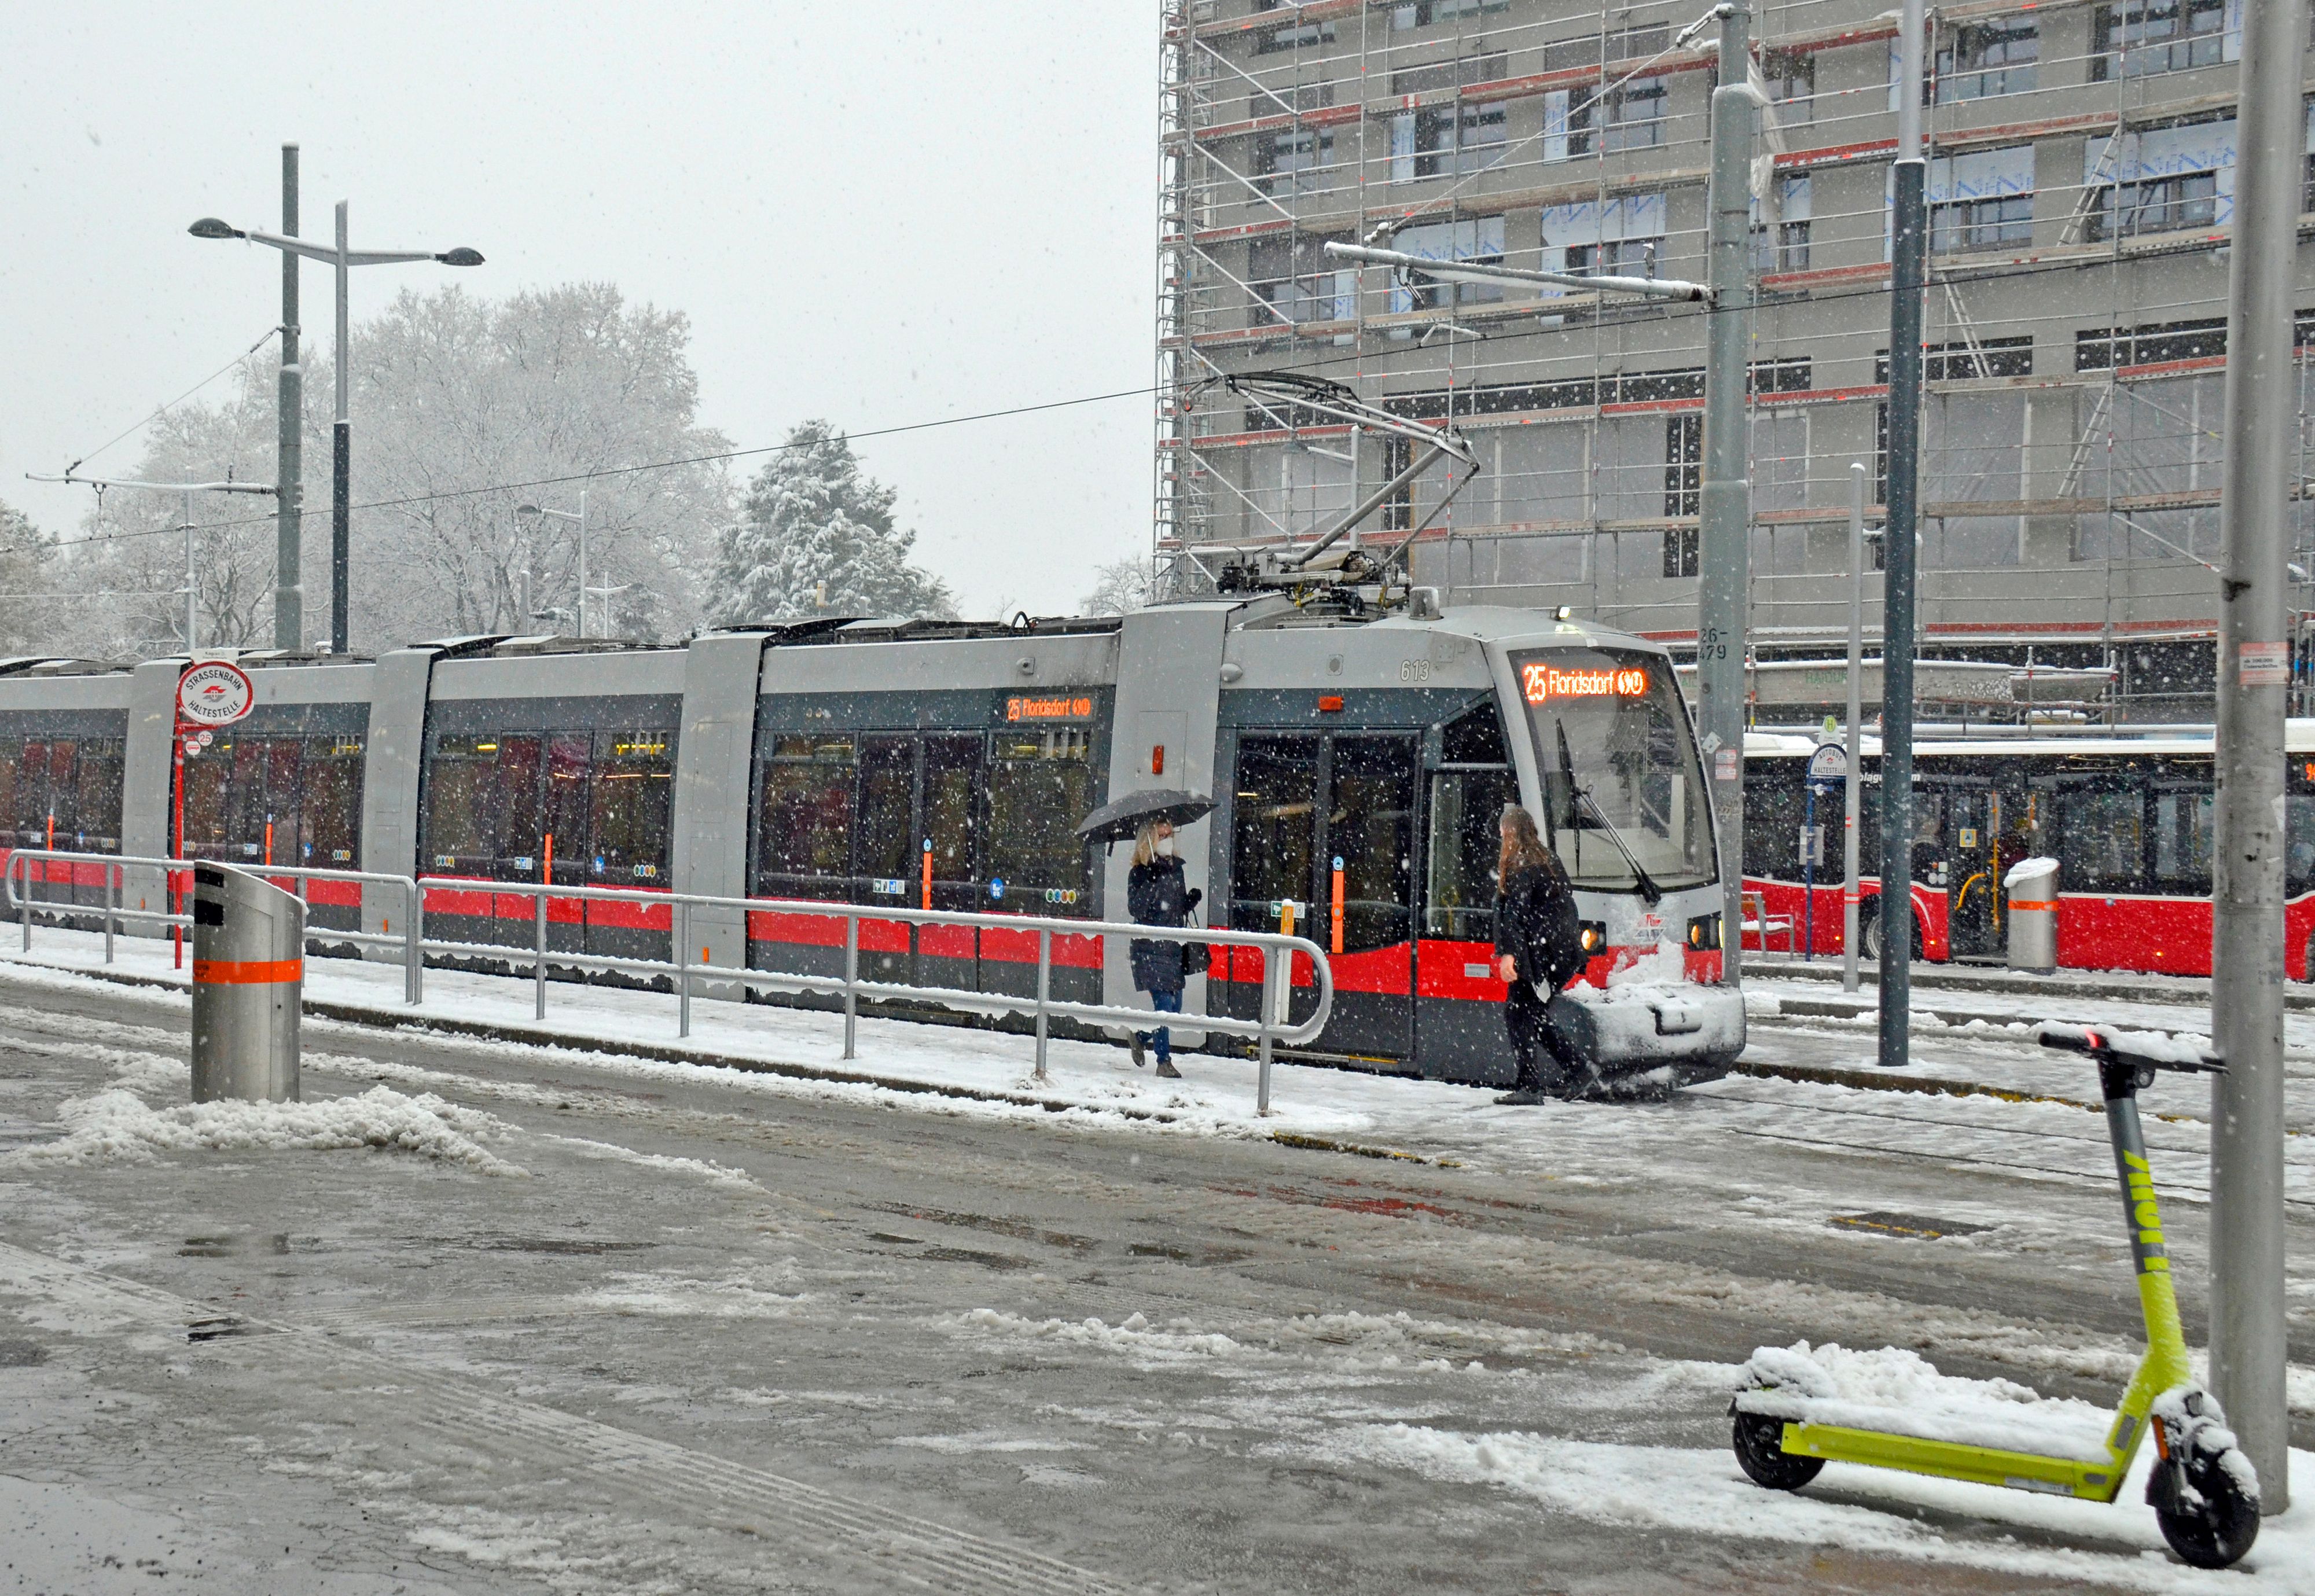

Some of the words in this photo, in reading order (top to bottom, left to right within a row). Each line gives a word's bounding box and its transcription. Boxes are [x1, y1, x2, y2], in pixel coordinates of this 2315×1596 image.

[1401, 659, 1430, 682] 613
[186, 670, 244, 691] STRASSENBAHN
[1524, 665, 1547, 702] 25
[1549, 670, 1614, 696] Floridsdorf
[188, 700, 241, 718] HALTESTELLE
[1008, 698, 1021, 721] 25
[1023, 698, 1071, 717] Floridsdorf
[200, 734, 211, 742] 25
[1818, 749, 1842, 761] AUTOBUS
[1814, 766, 1846, 774] HALTESTELLE
